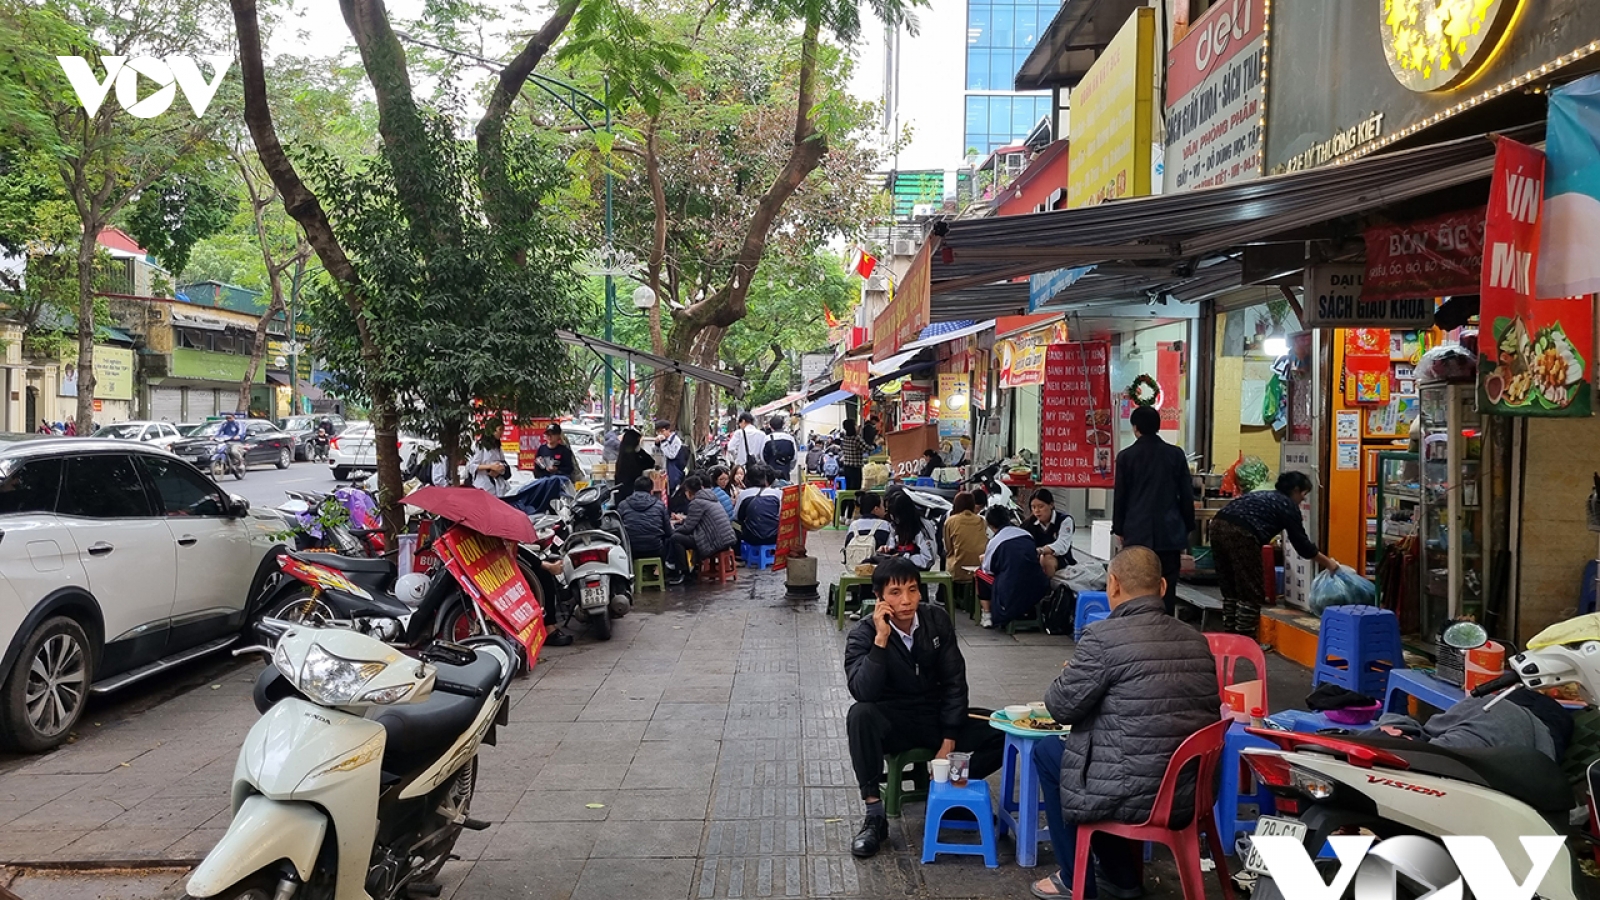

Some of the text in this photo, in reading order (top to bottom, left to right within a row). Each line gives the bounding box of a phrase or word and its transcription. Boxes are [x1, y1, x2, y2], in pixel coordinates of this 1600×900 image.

[1182, 93, 1258, 161] VĂN PHÒNG PHẨM
[1316, 126, 1358, 165] THƯỜNG
[1358, 109, 1385, 146] KIỆT
[1233, 134, 1247, 158] HỌC
[1330, 274, 1354, 288] ĐẠI
[1057, 427, 1071, 437] CAY
[1045, 442, 1061, 452] MILO
[1366, 774, 1447, 797] VISION
